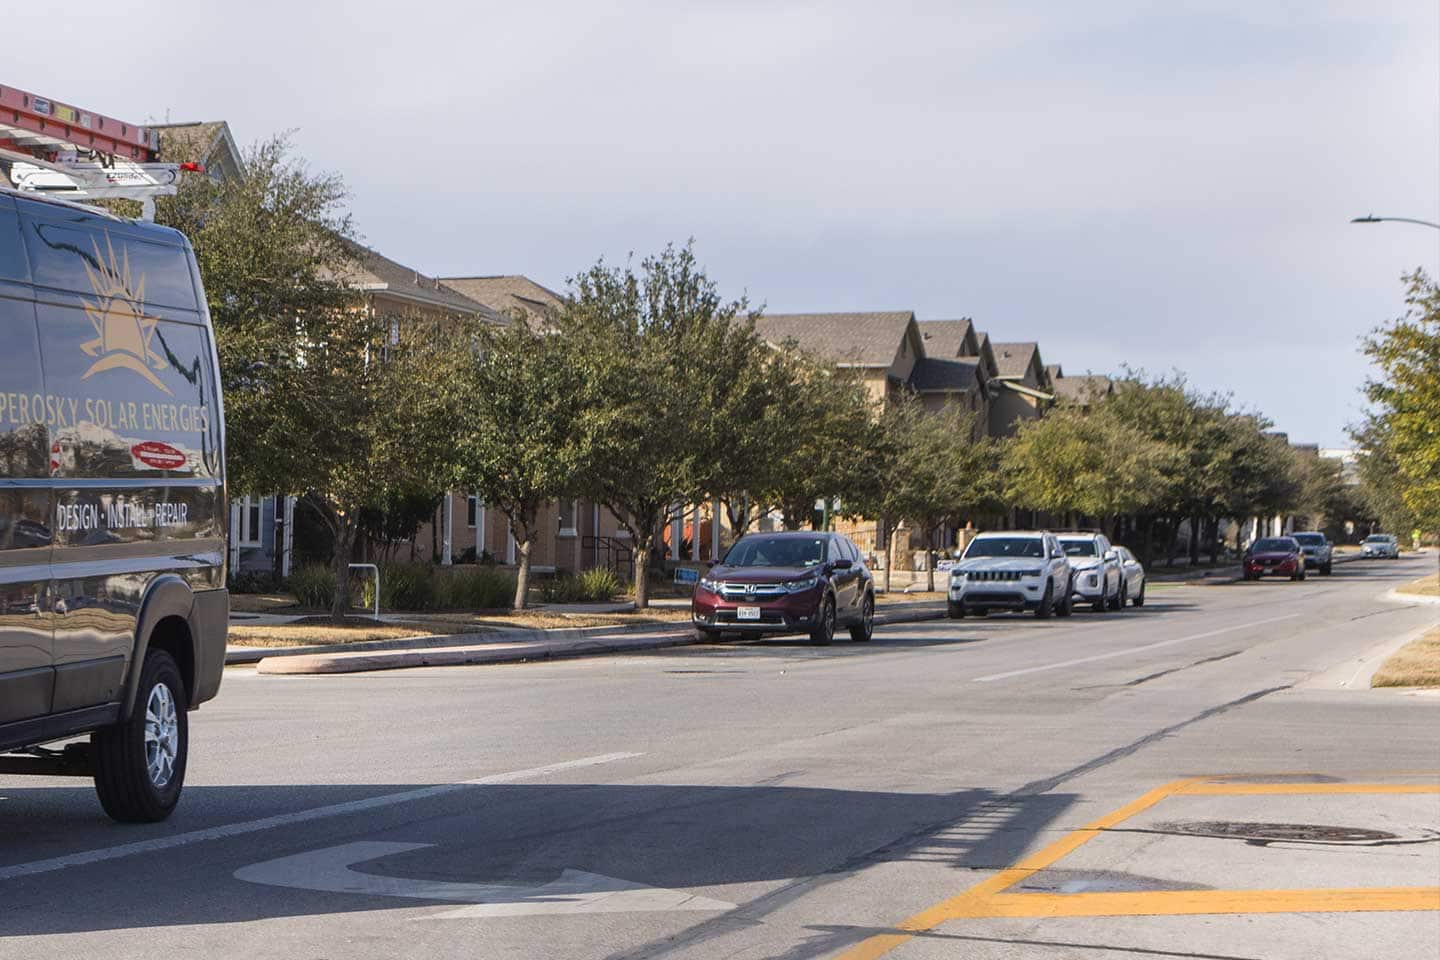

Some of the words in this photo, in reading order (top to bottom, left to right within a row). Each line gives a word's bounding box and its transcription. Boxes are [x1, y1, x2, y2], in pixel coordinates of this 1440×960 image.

[85, 398, 137, 431] SOLAR
[142, 403, 209, 433] ENERGIES
[59, 503, 98, 530] DESIGN
[107, 503, 147, 528] INSTALL
[155, 503, 188, 527] REPAIR
